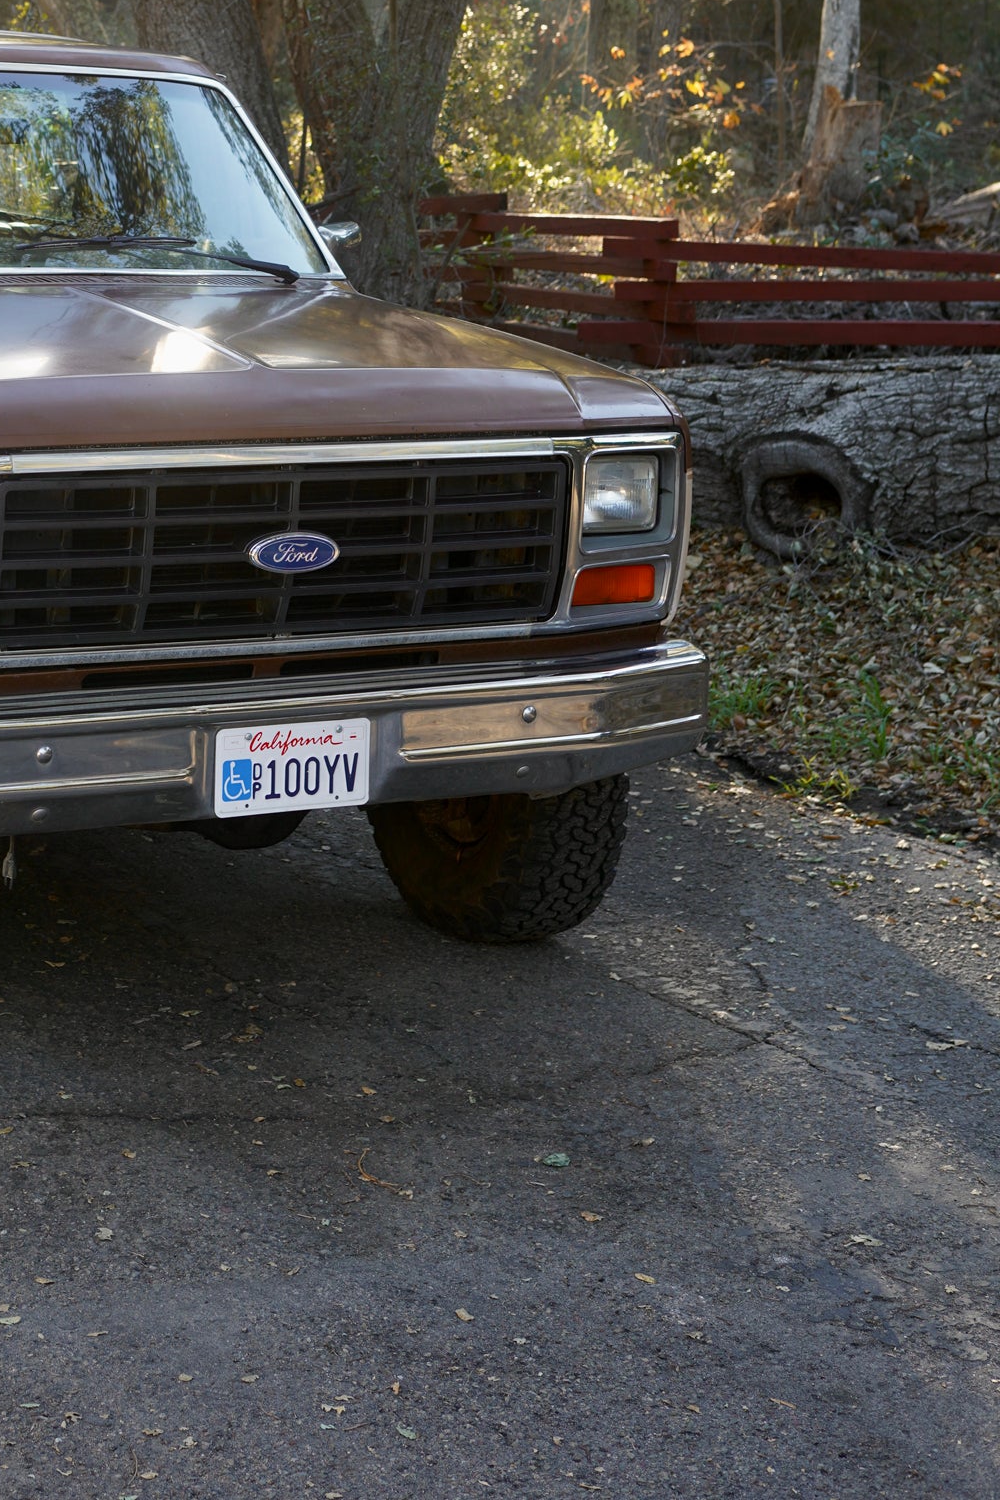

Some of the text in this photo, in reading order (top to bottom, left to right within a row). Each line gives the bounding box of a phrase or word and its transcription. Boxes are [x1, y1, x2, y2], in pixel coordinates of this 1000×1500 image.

[272, 542, 319, 564] Ford
[249, 729, 343, 756] California
[264, 752, 359, 800] 100YV
